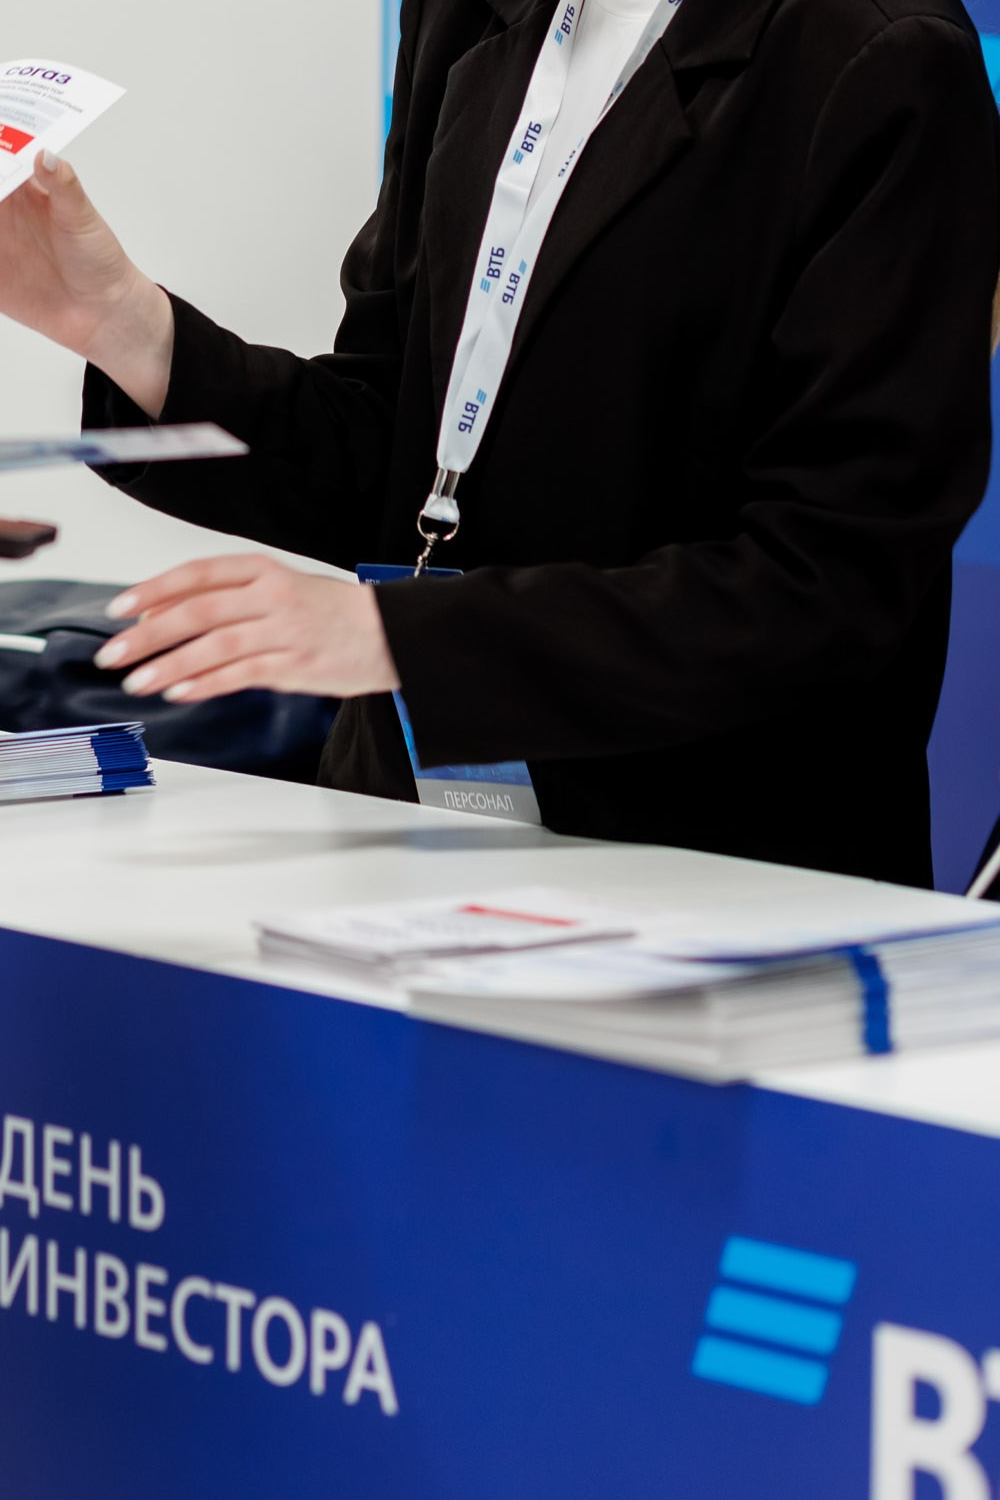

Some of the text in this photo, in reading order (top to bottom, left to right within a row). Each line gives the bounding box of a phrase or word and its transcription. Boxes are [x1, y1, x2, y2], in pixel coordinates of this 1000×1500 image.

[560, 3, 576, 36] ВТБ
[520, 121, 542, 154] ВТБ
[486, 246, 505, 279] ВТБ
[502, 272, 521, 305] ВТБ
[457, 401, 479, 434] ВТБ
[443, 790, 514, 812] ПЕРСОНАЛ
